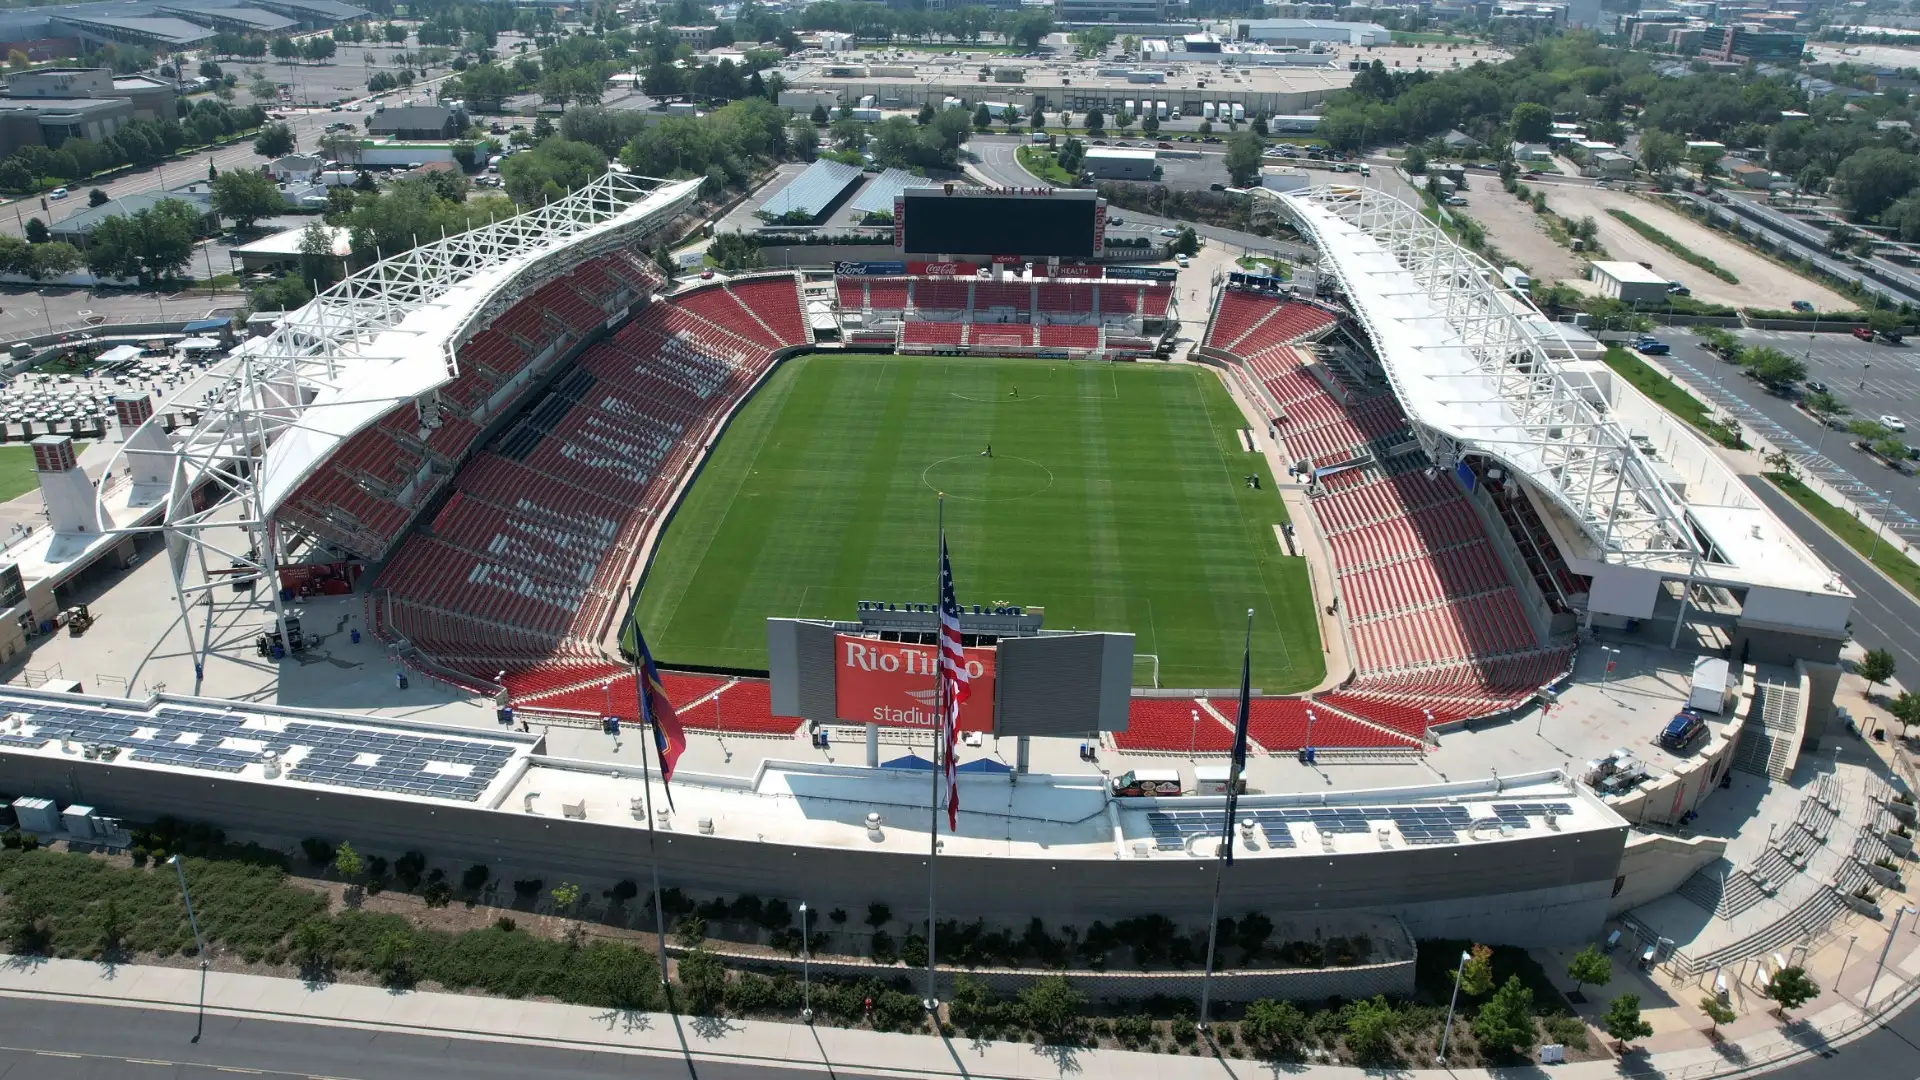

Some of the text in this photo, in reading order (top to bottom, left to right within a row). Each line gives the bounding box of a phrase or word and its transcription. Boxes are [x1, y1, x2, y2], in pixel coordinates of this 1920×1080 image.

[984, 186, 1016, 196] SALT
[1019, 187, 1056, 197] LAKE
[837, 261, 868, 275] Ford
[1060, 267, 1089, 275] HEALTH
[845, 641, 984, 679] RioTio
